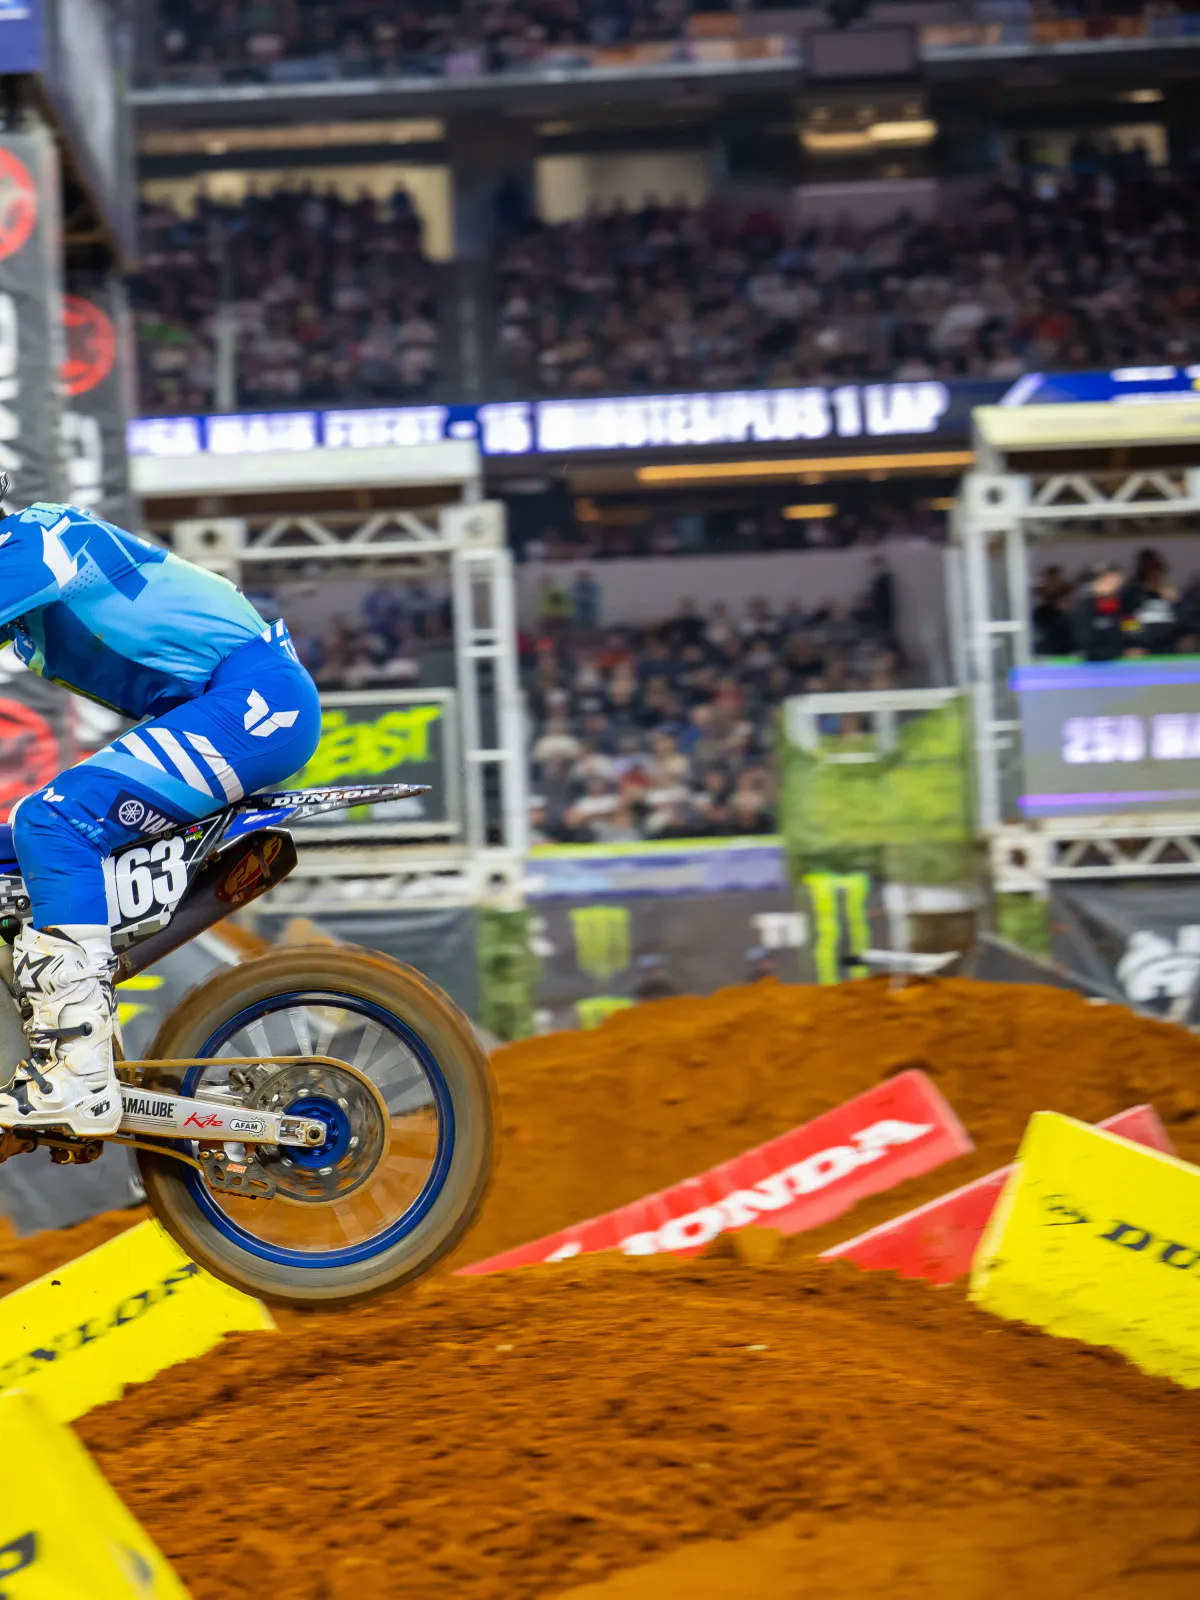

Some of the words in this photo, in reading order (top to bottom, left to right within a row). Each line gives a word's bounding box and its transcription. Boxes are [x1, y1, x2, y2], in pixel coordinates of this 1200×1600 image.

[272, 788, 382, 808] DUNLOP
[101, 836, 188, 928] 163
[121, 1096, 175, 1118] AMALUBE
[183, 1111, 224, 1129] Kite
[234, 1123, 258, 1131] AFAM
